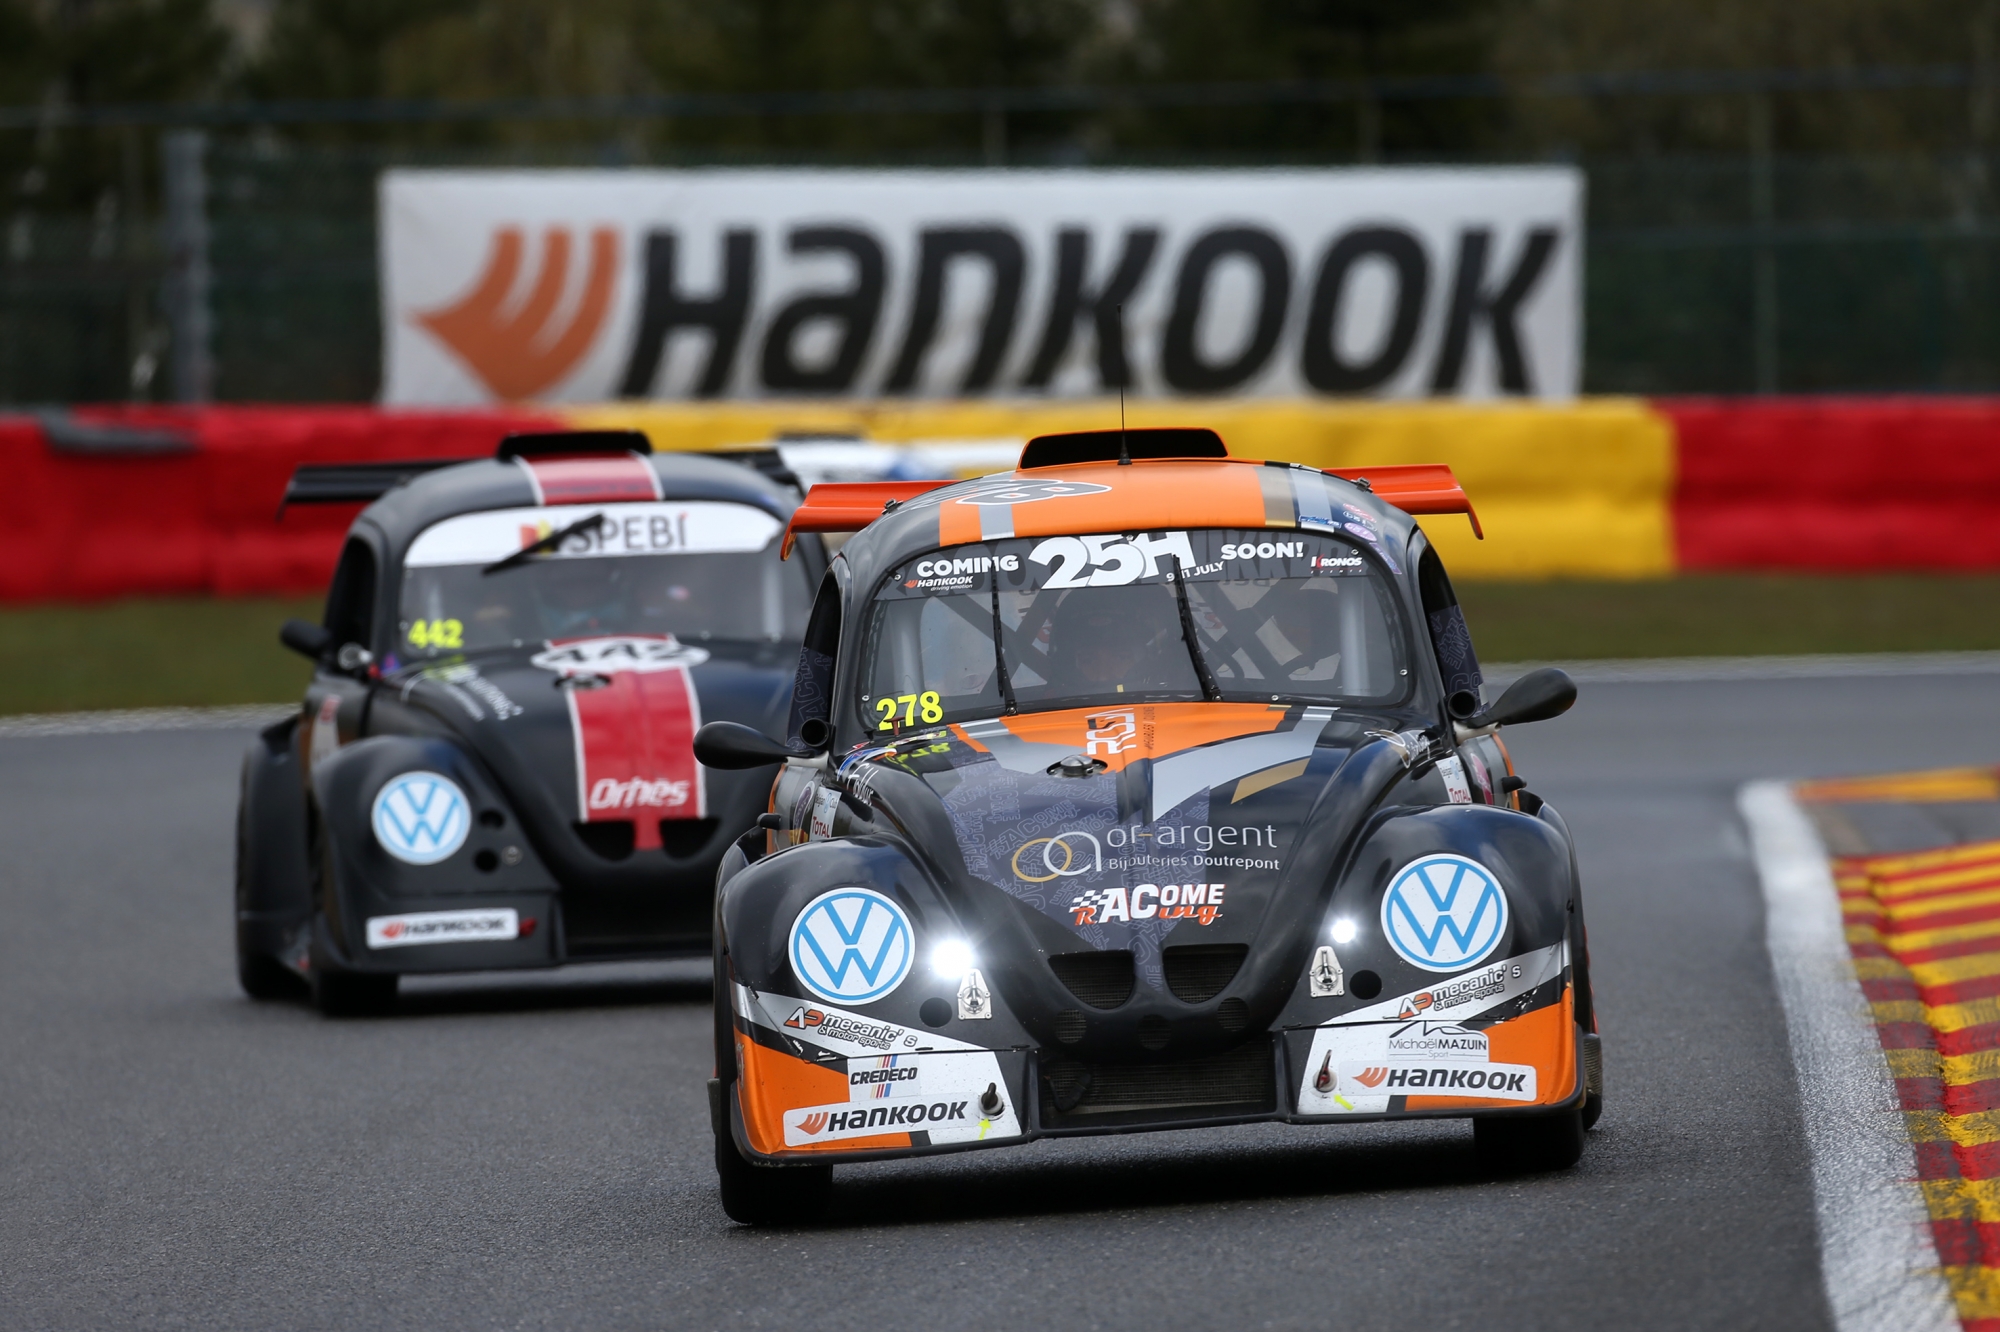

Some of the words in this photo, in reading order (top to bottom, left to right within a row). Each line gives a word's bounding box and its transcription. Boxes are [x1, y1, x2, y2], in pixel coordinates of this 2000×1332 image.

[1220, 541, 1304, 561] SOON!
[1310, 554, 1363, 568] KRONOS
[916, 554, 1019, 577] COMING
[1193, 560, 1225, 576] JULY
[930, 584, 950, 592] driving
[407, 618, 464, 649] 442
[876, 690, 943, 731] 278
[1108, 853, 1188, 873] Bijouteries
[1193, 855, 1280, 871] Doutrepont
[1444, 991, 1475, 1009] motor
[1474, 983, 1505, 1001] sports
[827, 1026, 859, 1043] motor
[858, 1036, 891, 1050] sports
[1427, 1051, 1449, 1060] Sport
[850, 1067, 918, 1086] CREDECO
